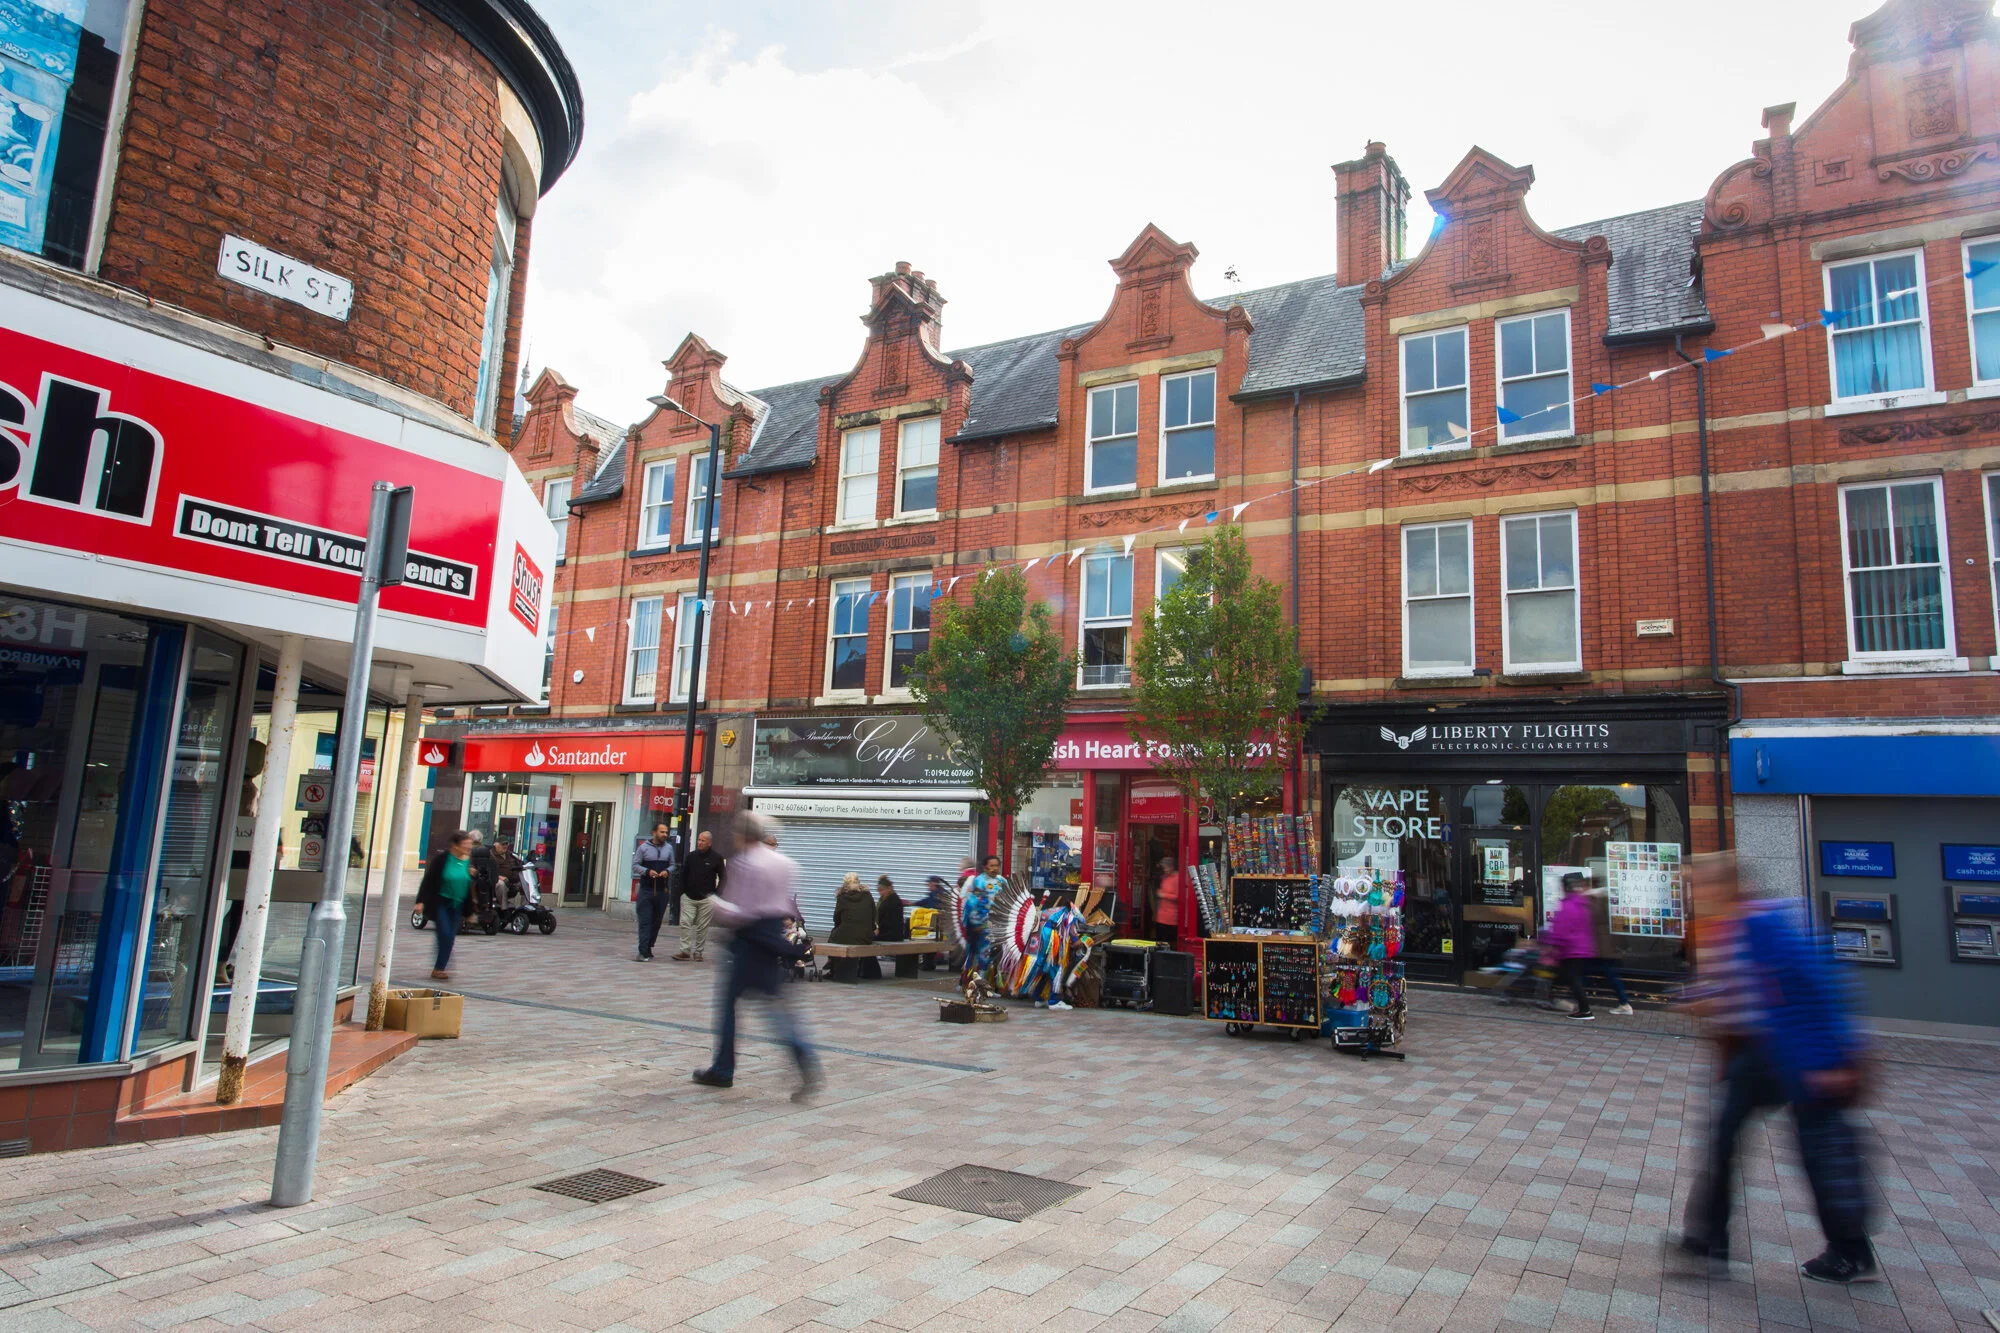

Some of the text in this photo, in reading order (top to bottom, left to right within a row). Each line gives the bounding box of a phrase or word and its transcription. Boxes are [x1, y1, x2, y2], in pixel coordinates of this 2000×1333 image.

[236, 250, 339, 305] SILK ST
[191, 509, 258, 544] Dont
[264, 525, 311, 556] Tell
[317, 537, 364, 568] You
[515, 553, 541, 611] Shush
[1431, 723, 1609, 739] LIBERTY FLIGHTS
[547, 743, 627, 766] Santander
[853, 718, 928, 776] Cafe
[1085, 739, 1141, 758] Heart
[1432, 741, 1609, 750] ELECTRONIC CIGARETTES
[1363, 789, 1430, 812] VAPE
[880, 806, 895, 815] here
[903, 807, 914, 815] Eat
[933, 807, 965, 817] Takeaway
[1353, 815, 1441, 839] STORE
[1489, 860, 1505, 871] CBD
[1833, 863, 1884, 872] cash machine
[1956, 867, 1975, 876] cash
